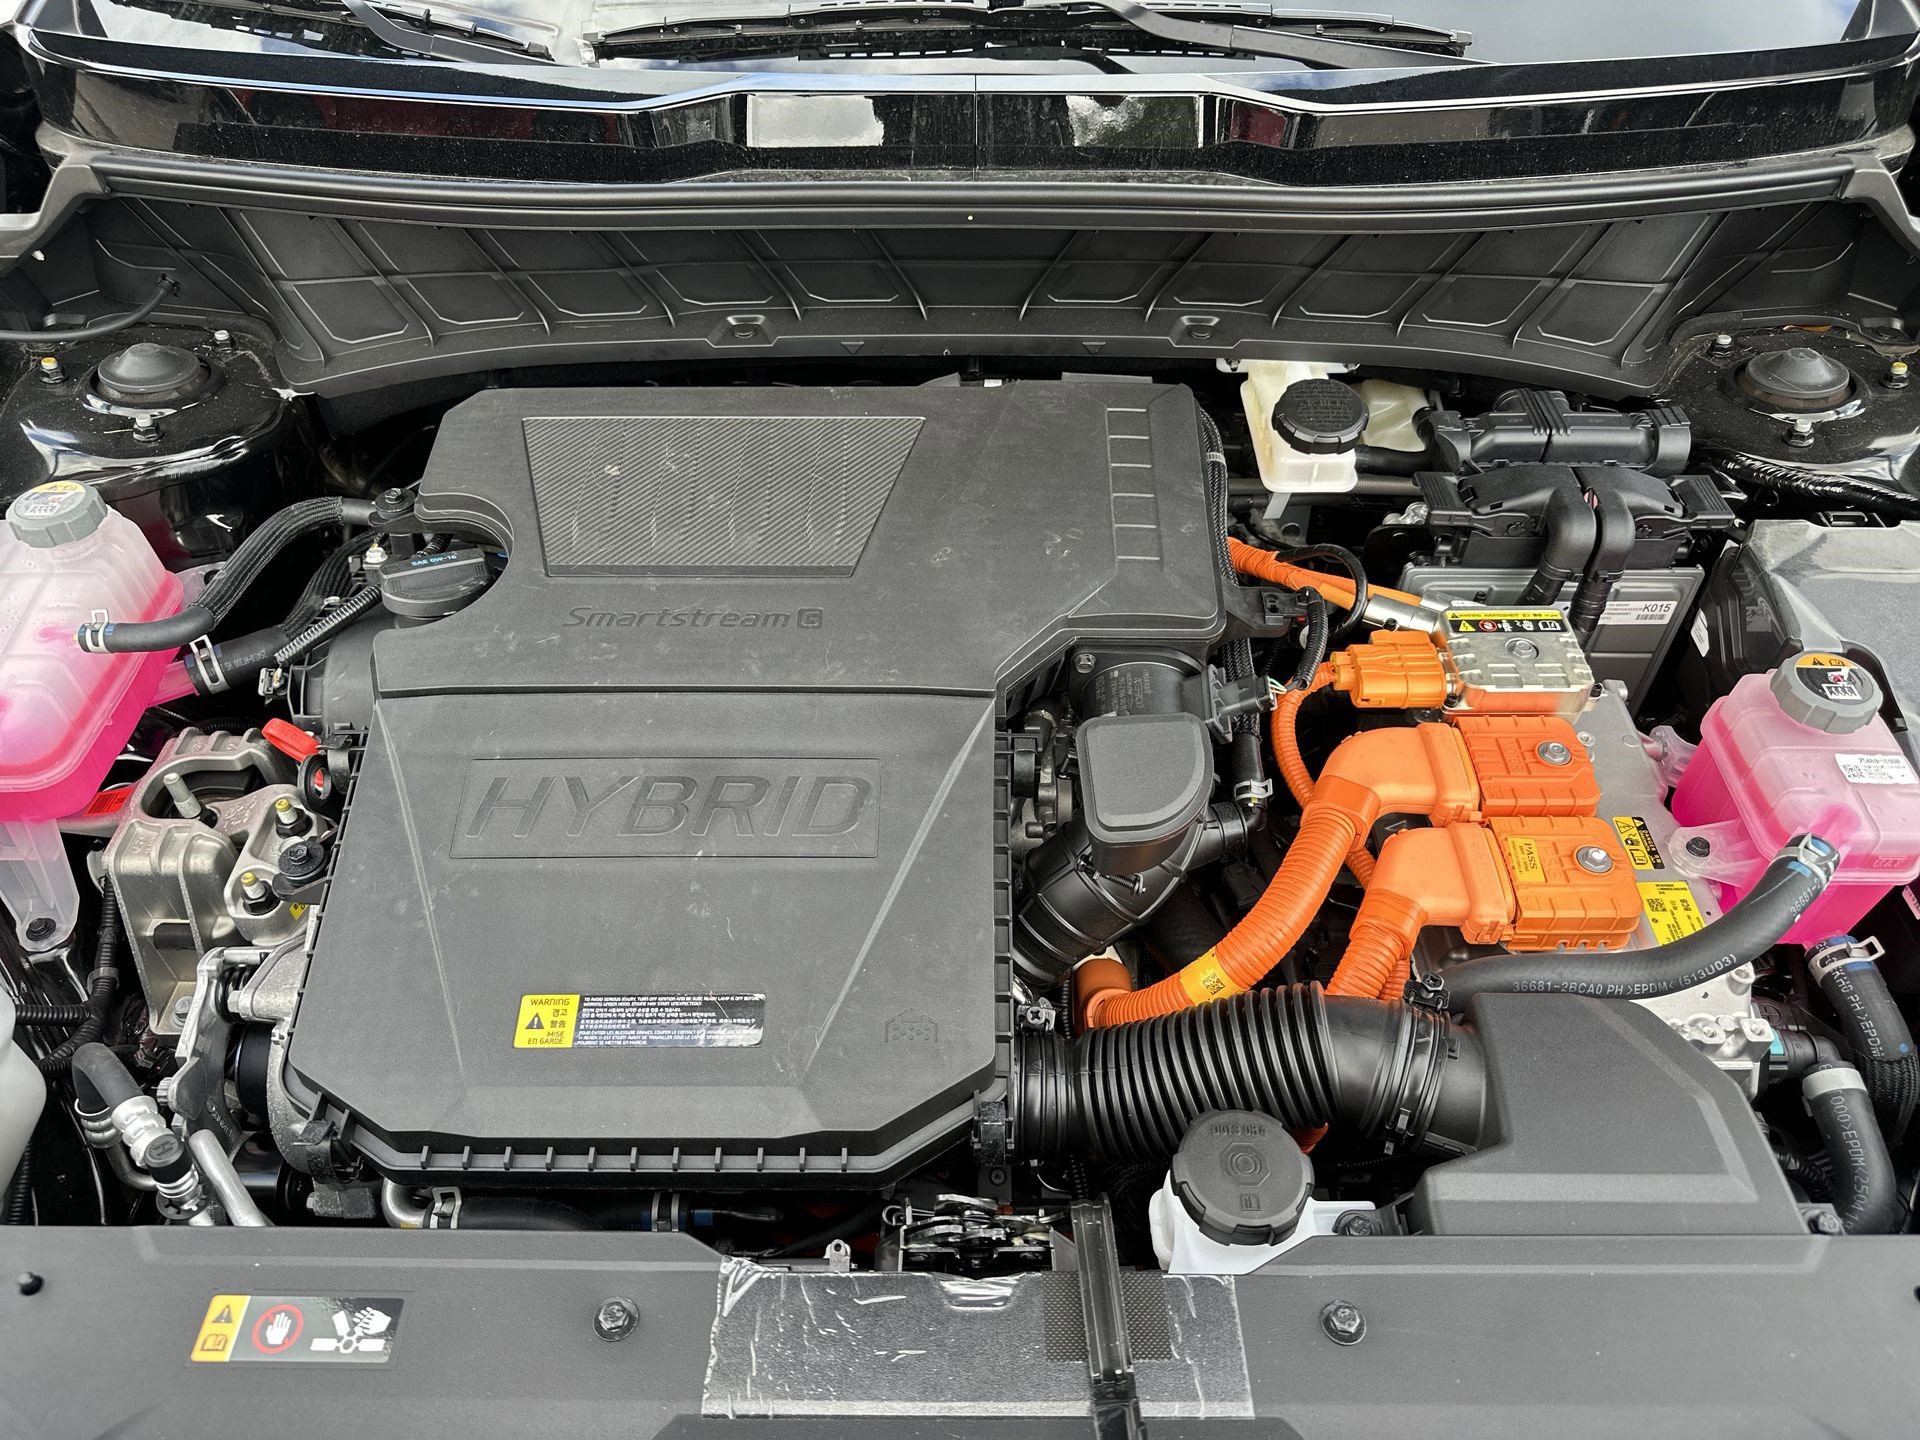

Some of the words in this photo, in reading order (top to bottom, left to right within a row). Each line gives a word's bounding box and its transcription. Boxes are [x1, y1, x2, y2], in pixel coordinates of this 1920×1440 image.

[410, 559, 429, 567] SAE
[429, 554, 458, 564] 0W-16
[1642, 603, 1672, 613] K015
[562, 604, 791, 628] Smartstream
[465, 775, 873, 838] HYBRID
[1524, 842, 1538, 870] PASS
[1512, 981, 1603, 995] 36681-2BCA0
[1606, 984, 1624, 996] PH
[530, 998, 570, 1006] WARNING
[552, 1008, 568, 1017] 경고
[527, 1037, 538, 1045] EN
[539, 1037, 565, 1045] GARDE
